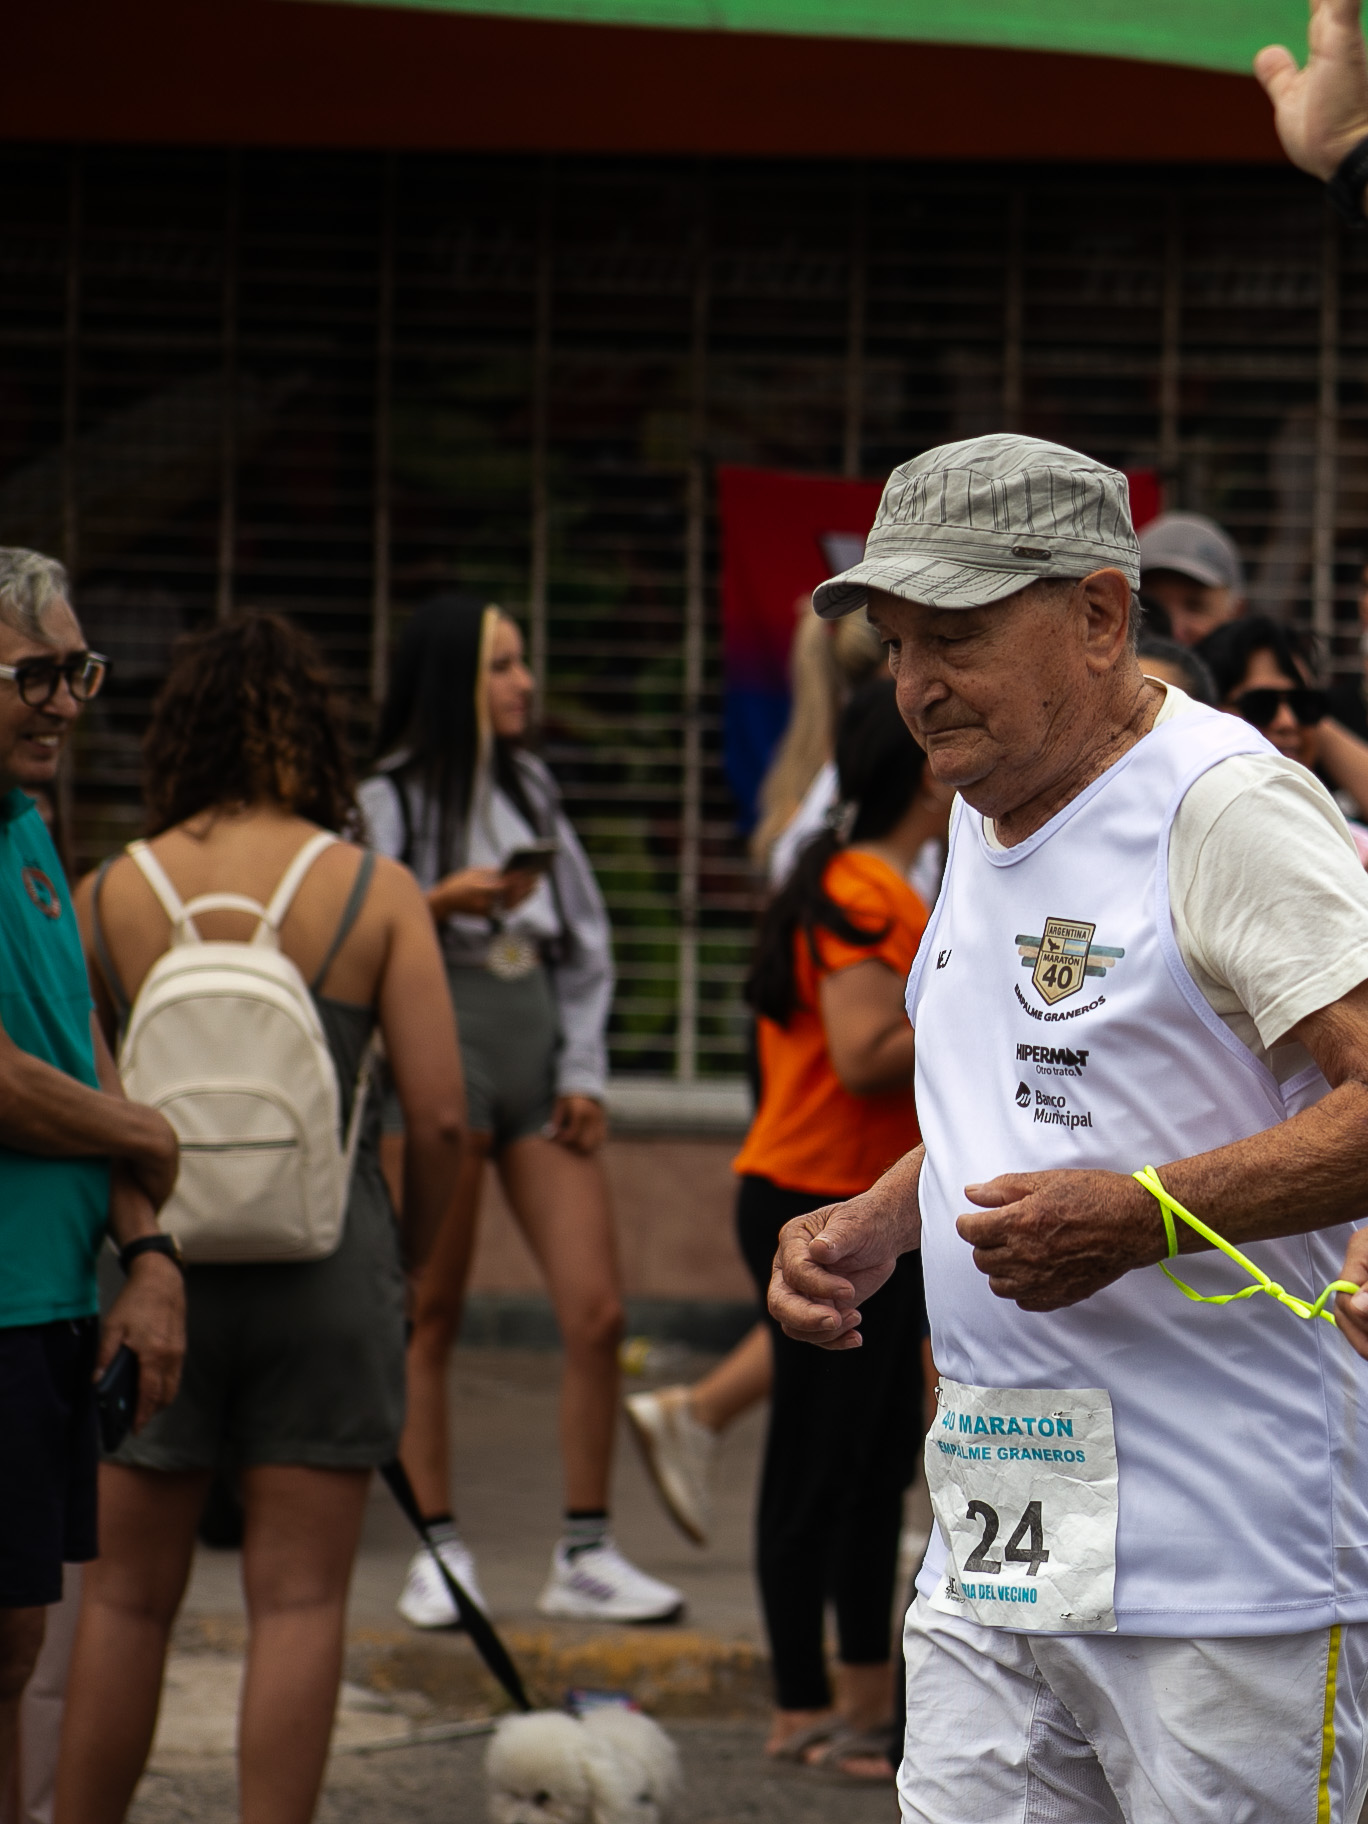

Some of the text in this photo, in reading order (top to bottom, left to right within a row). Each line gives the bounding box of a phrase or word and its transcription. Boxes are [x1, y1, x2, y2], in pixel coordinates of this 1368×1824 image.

[1049, 925, 1087, 939] ARGENTINA
[1042, 964, 1073, 989] 40
[1014, 983, 1107, 1022] EMPALME GRANEROS
[1036, 1065, 1052, 1075] Otro
[1035, 1090, 1066, 1108] Banco
[1034, 1108, 1093, 1130] Municipal
[959, 1414, 1073, 1438] MARATON
[938, 1441, 1086, 1463] EMPALME GRANEROS
[963, 1500, 1050, 1577] 24
[979, 1584, 996, 1600] DEL
[998, 1585, 1037, 1604] VECINO
